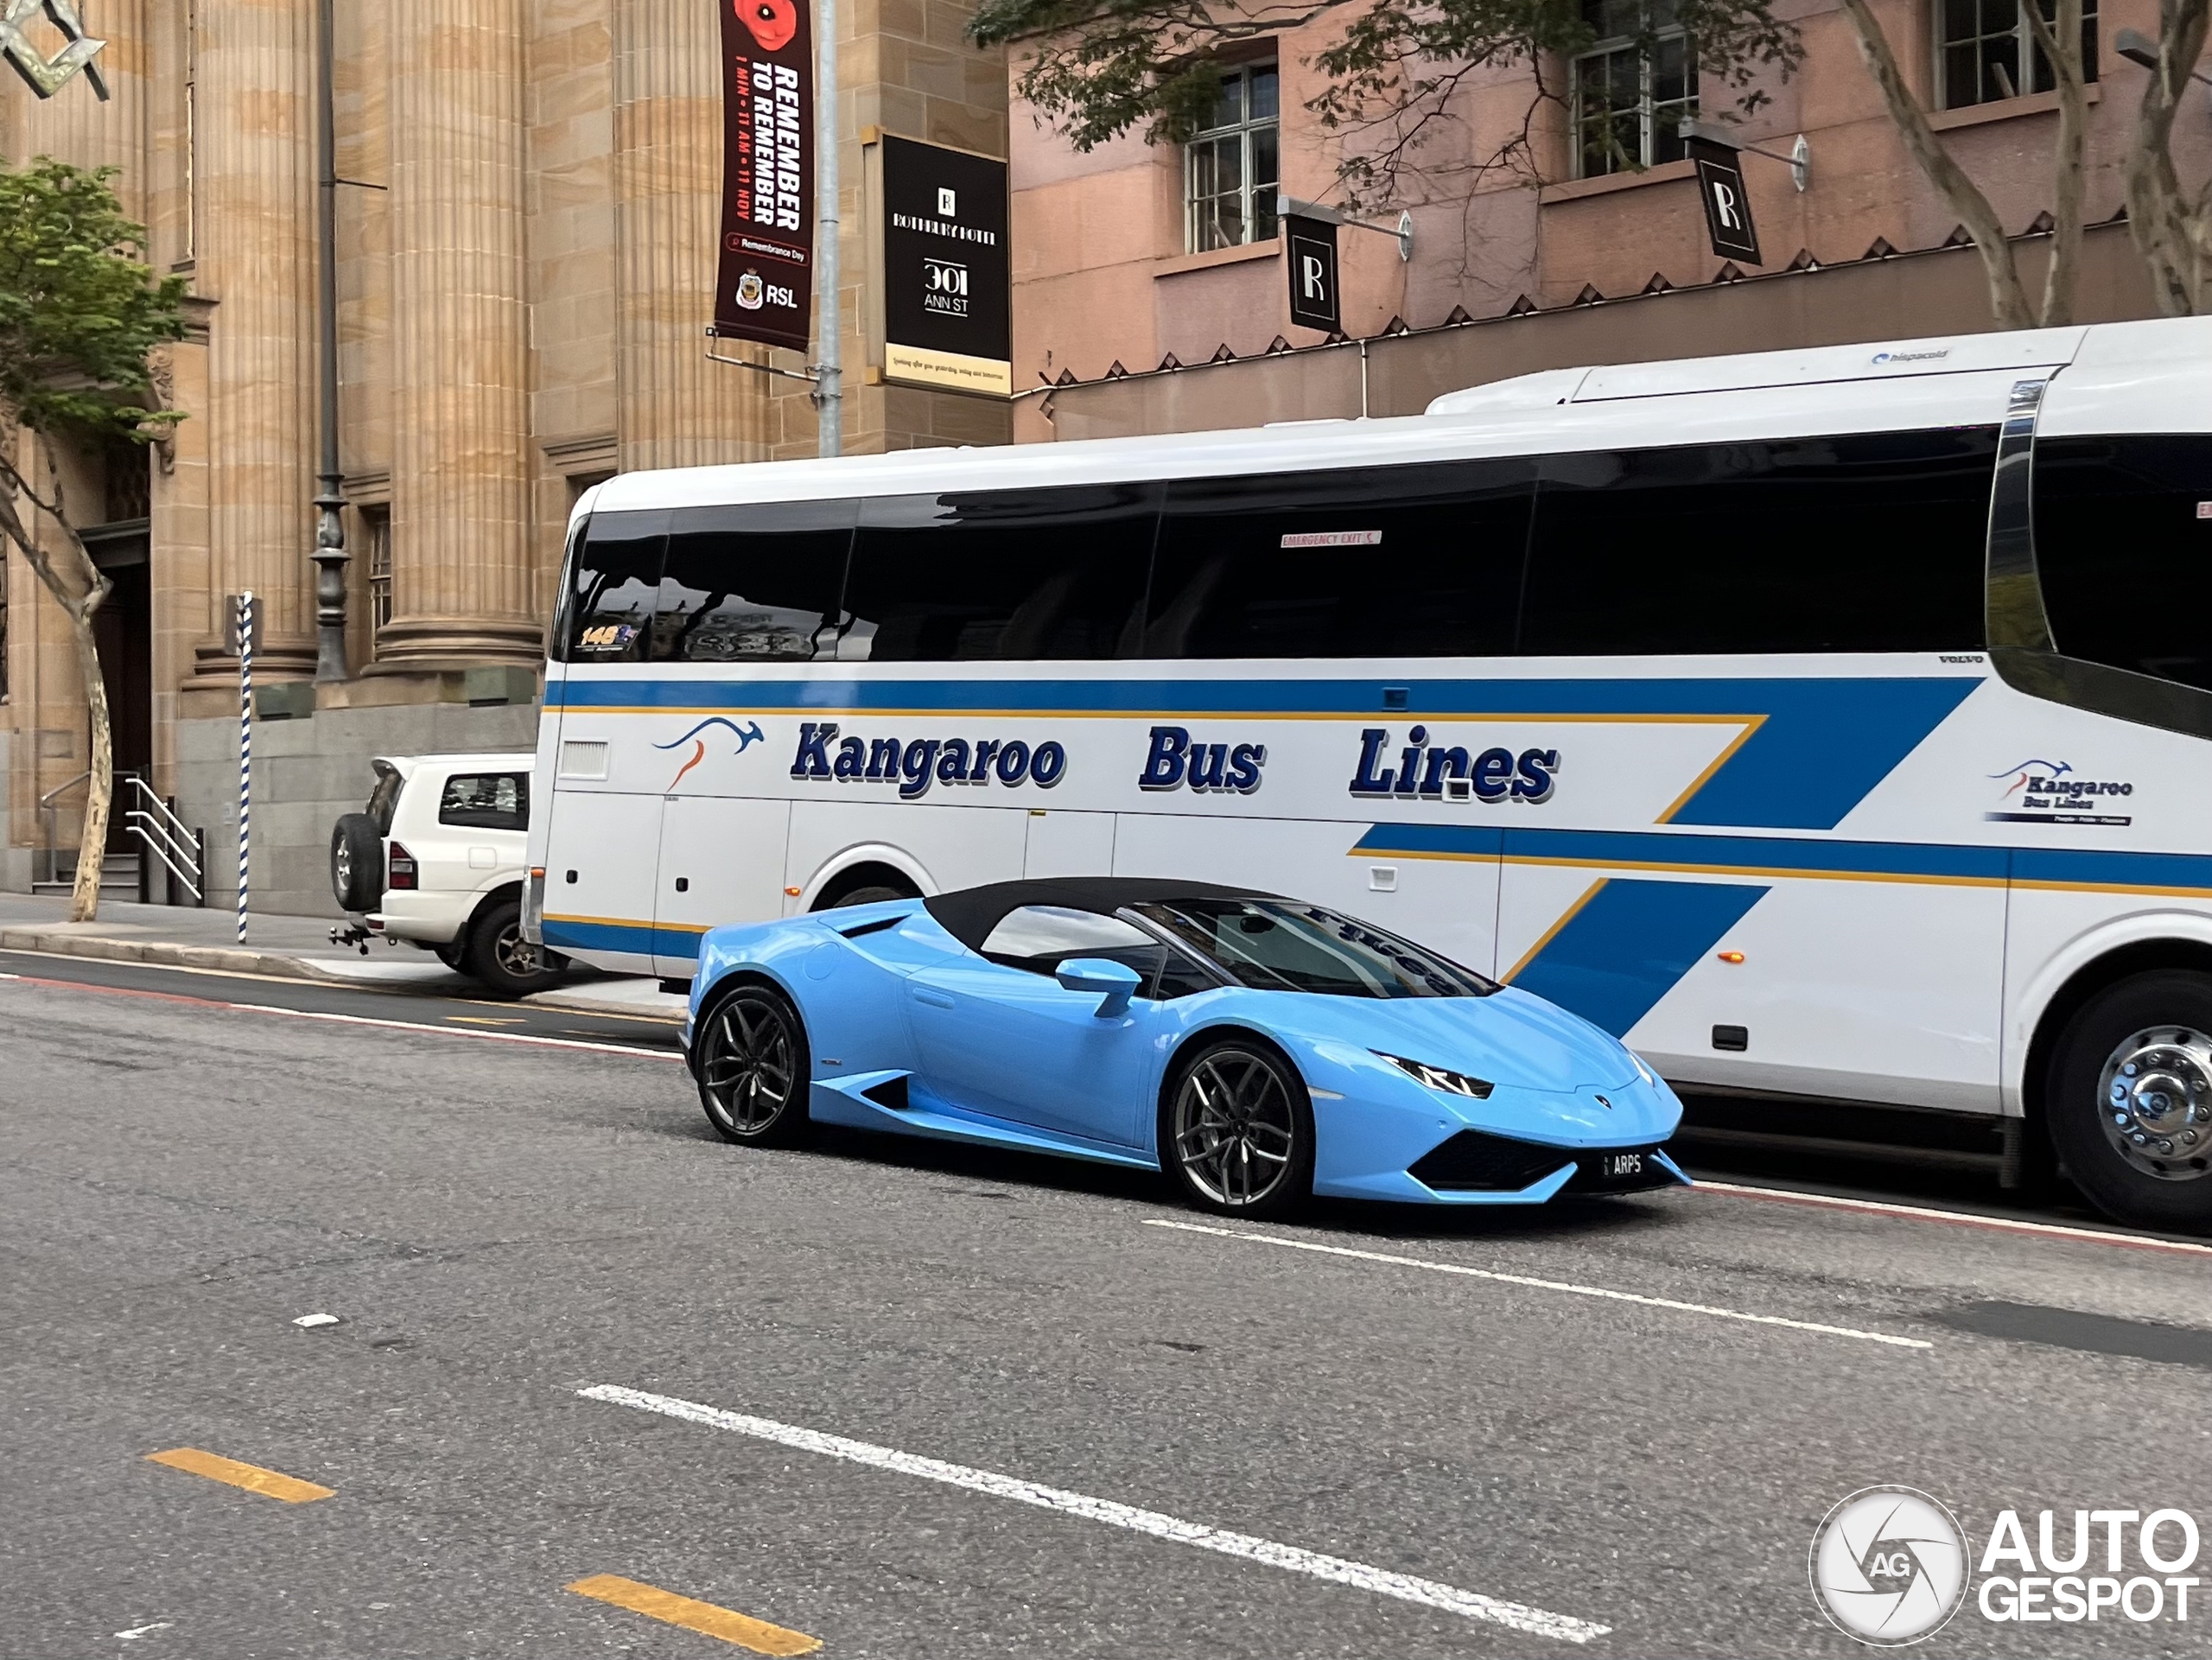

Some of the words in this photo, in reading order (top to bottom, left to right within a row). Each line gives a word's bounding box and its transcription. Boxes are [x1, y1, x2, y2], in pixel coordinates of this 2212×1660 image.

[736, 67, 749, 97] MIN
[753, 62, 773, 92] TO
[738, 111, 750, 126] 11
[738, 130, 750, 154] AM
[774, 65, 800, 231] REMEMBER
[754, 95, 775, 226] REMEMBER
[738, 169, 750, 184] 11
[736, 188, 750, 220] NOV
[943, 194, 951, 210] R
[1713, 181, 1741, 230] R
[893, 213, 958, 238] ROTHBURY
[960, 226, 996, 246] HOTEL
[741, 238, 791, 258] Remembrance
[791, 249, 804, 263] Day
[924, 263, 968, 296] 301
[1303, 255, 1325, 301] R
[766, 284, 798, 308] RSL
[924, 293, 950, 310] ANN
[953, 298, 969, 312] ST
[1283, 534, 1338, 547] EMERGENCY
[1341, 532, 1363, 544] EXIT
[790, 722, 1068, 800] Kangaroo
[1139, 726, 1268, 795] Bus
[1348, 725, 1560, 805] Lines
[2026, 776, 2133, 798] Kangaroo
[2022, 796, 2050, 808] Bus
[2053, 796, 2094, 809] Lines
[1614, 1154, 1642, 1174] ARPS
